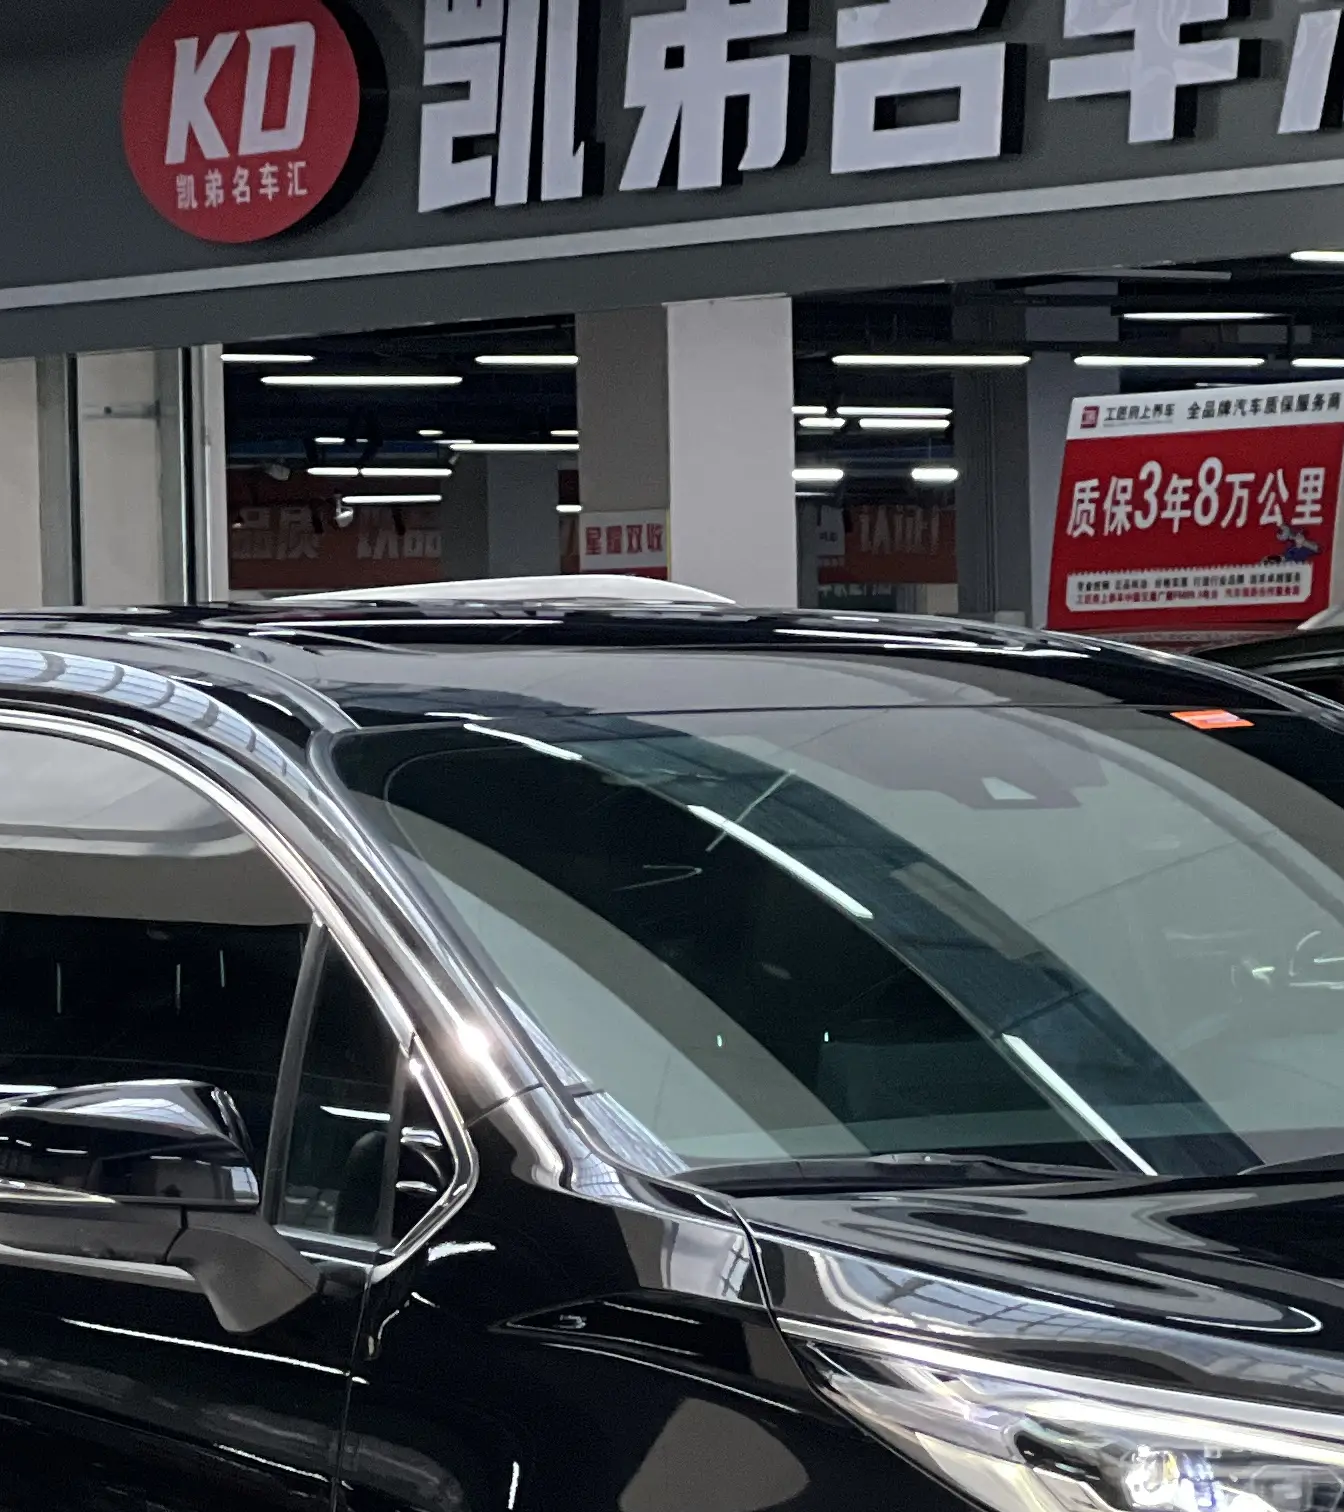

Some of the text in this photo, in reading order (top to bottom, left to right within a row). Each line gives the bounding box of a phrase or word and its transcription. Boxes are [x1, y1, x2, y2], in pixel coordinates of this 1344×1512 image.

[164, 21, 317, 166] KD
[175, 160, 310, 211] 凯弟名车汇
[1066, 456, 1326, 538] 质保3年8万公里
